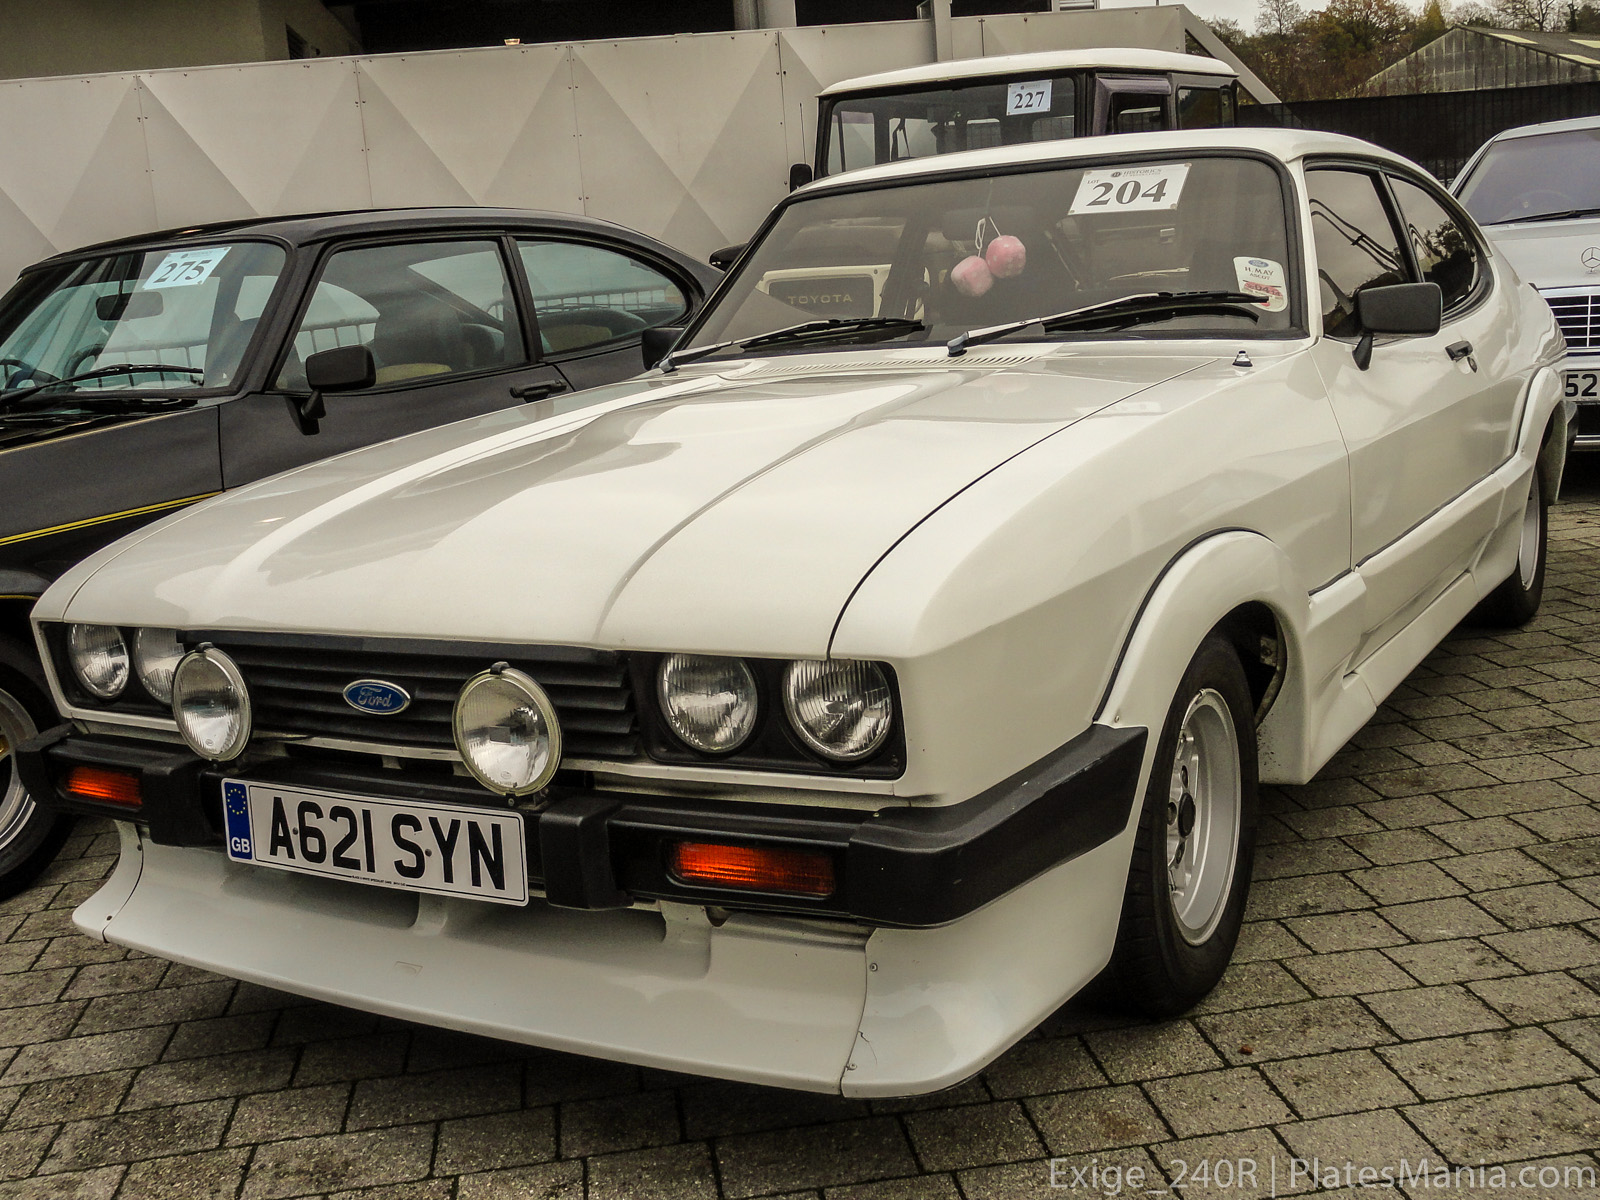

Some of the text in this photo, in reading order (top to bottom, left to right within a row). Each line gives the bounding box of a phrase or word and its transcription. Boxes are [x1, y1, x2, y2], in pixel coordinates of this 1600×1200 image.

[1014, 91, 1045, 109] 227
[1086, 178, 1168, 206] 204
[153, 260, 213, 283] 275
[787, 294, 853, 305] TOYOTA
[1565, 373, 1598, 397] 52
[357, 686, 393, 707] Ford
[231, 837, 250, 853] GB
[269, 796, 506, 891] A621 SYN
